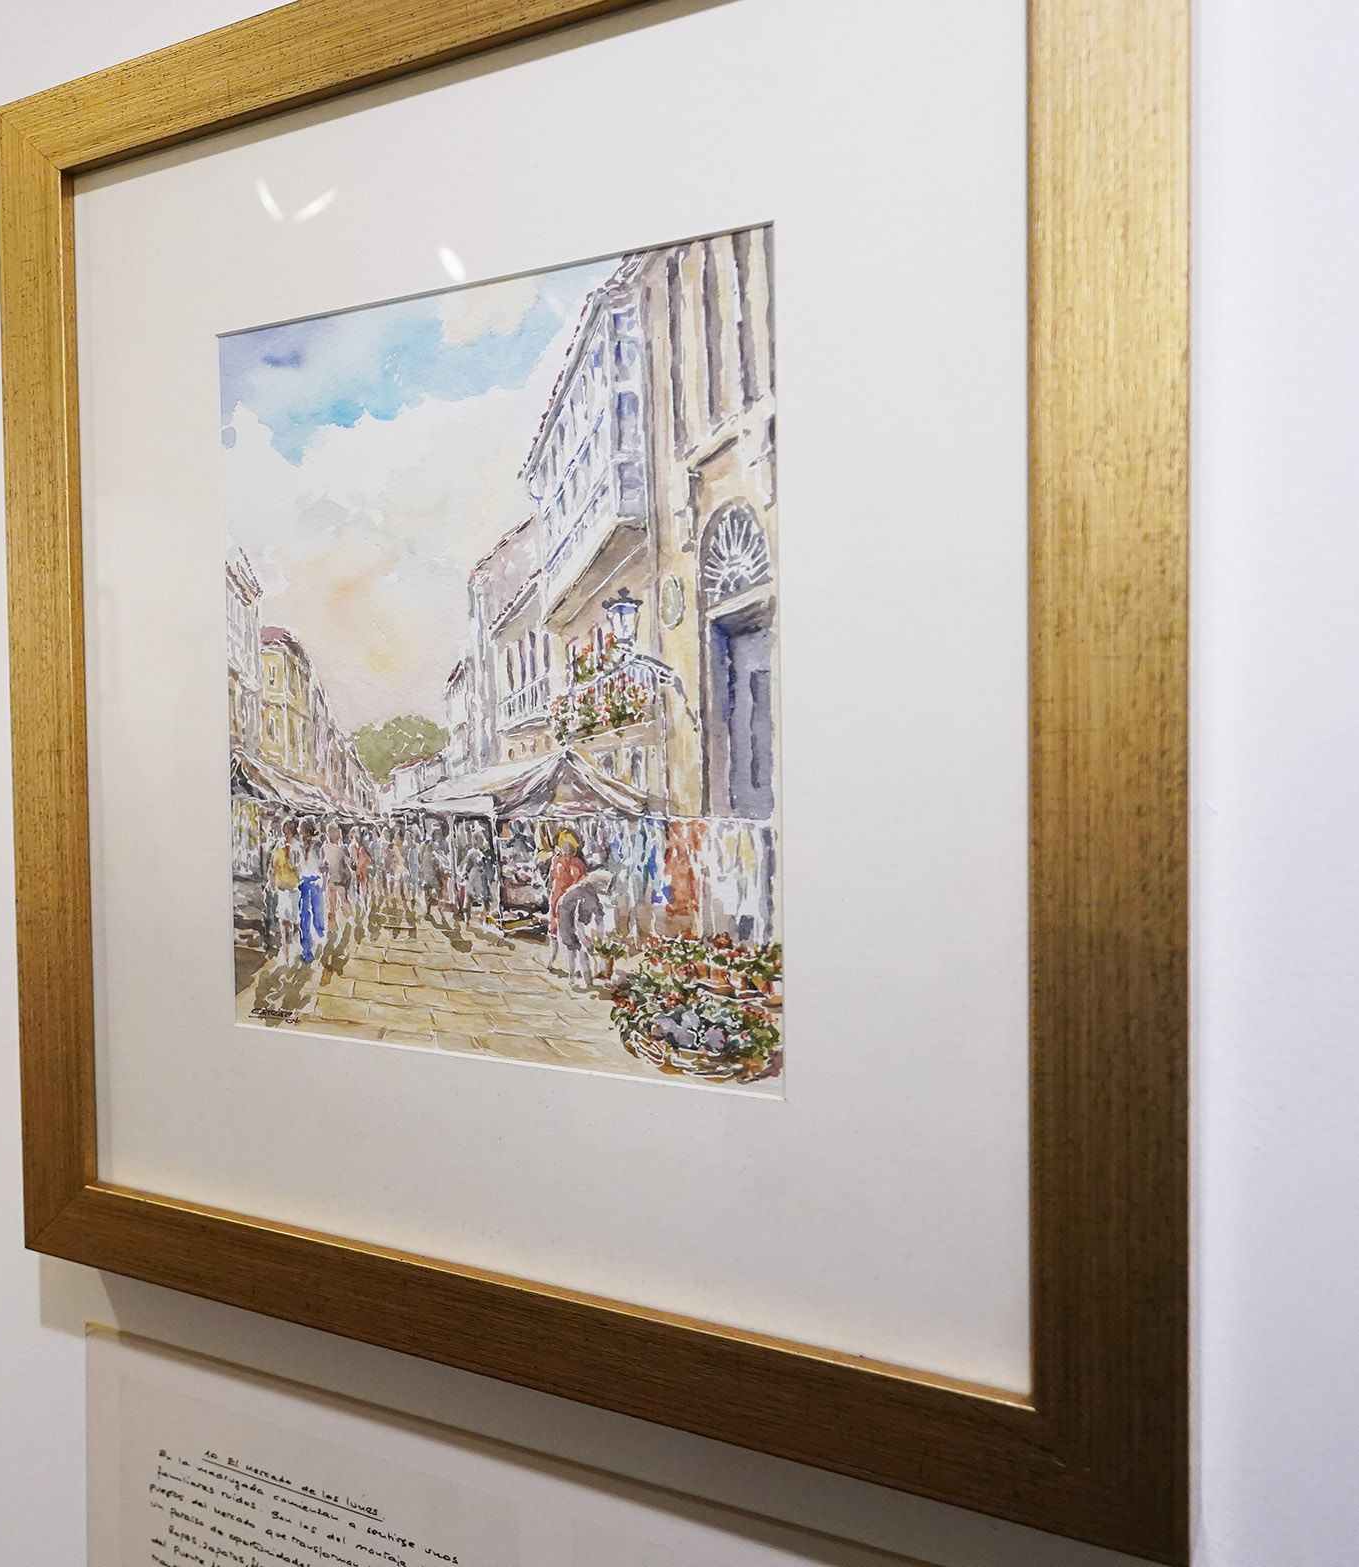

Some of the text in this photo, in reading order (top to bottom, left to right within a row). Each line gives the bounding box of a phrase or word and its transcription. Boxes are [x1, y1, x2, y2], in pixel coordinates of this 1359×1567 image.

[157, 1465, 215, 1495] familiares
[300, 1521, 317, 1533] los
[327, 1533, 346, 1544] del
[178, 1457, 190, 1466] la
[197, 1466, 264, 1495] madrugada
[273, 1495, 339, 1520] comienzan
[367, 1527, 415, 1548] sentirse
[425, 1548, 458, 1564] unos
[301, 1486, 316, 1495] de
[322, 1490, 339, 1502] los
[210, 1526, 223, 1536] de
[265, 1529, 286, 1540] que
[291, 1536, 358, 1567] transforman
